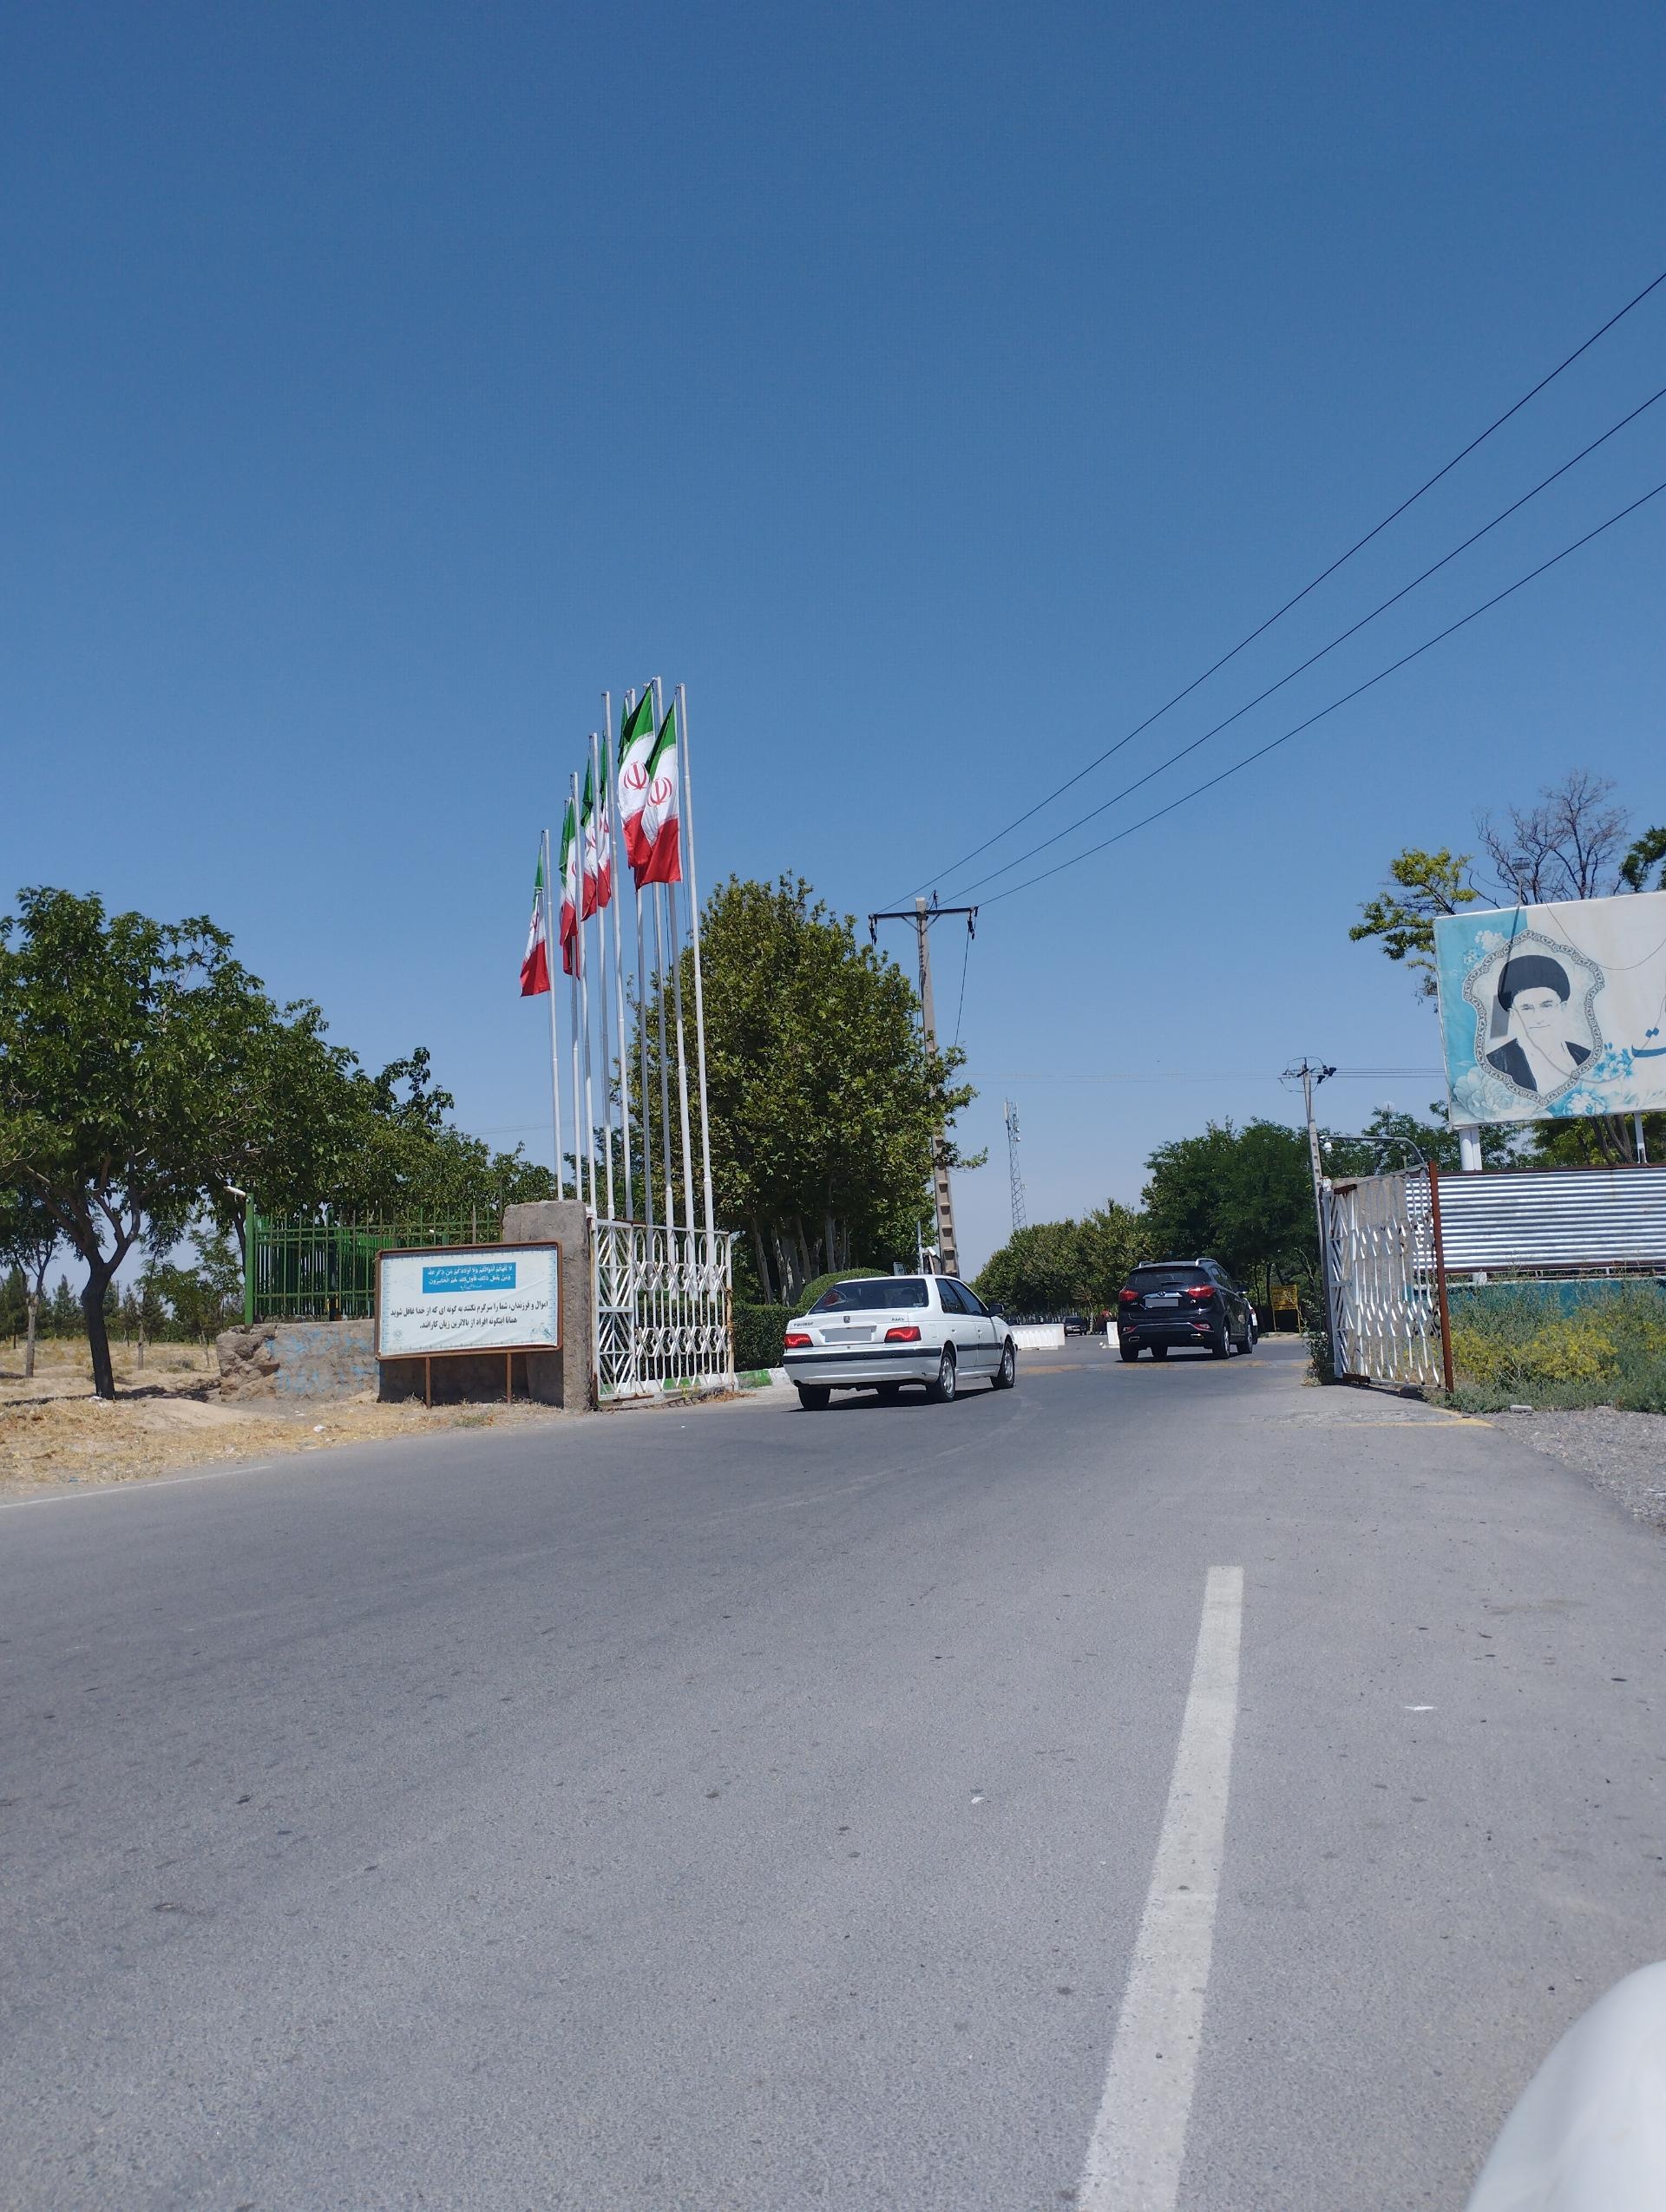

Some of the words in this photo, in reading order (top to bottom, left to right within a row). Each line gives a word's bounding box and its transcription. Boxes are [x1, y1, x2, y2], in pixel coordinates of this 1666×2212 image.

[476, 1303, 493, 1313] سرگرم
[493, 1303, 499, 1312] را
[535, 1300, 548, 1310] اموال
[390, 1307, 403, 1319] شوید
[403, 1307, 415, 1318] غافل
[425, 1306, 431, 1316] از
[451, 1318, 469, 1329] بالاترین
[476, 1318, 488, 1327] افراد
